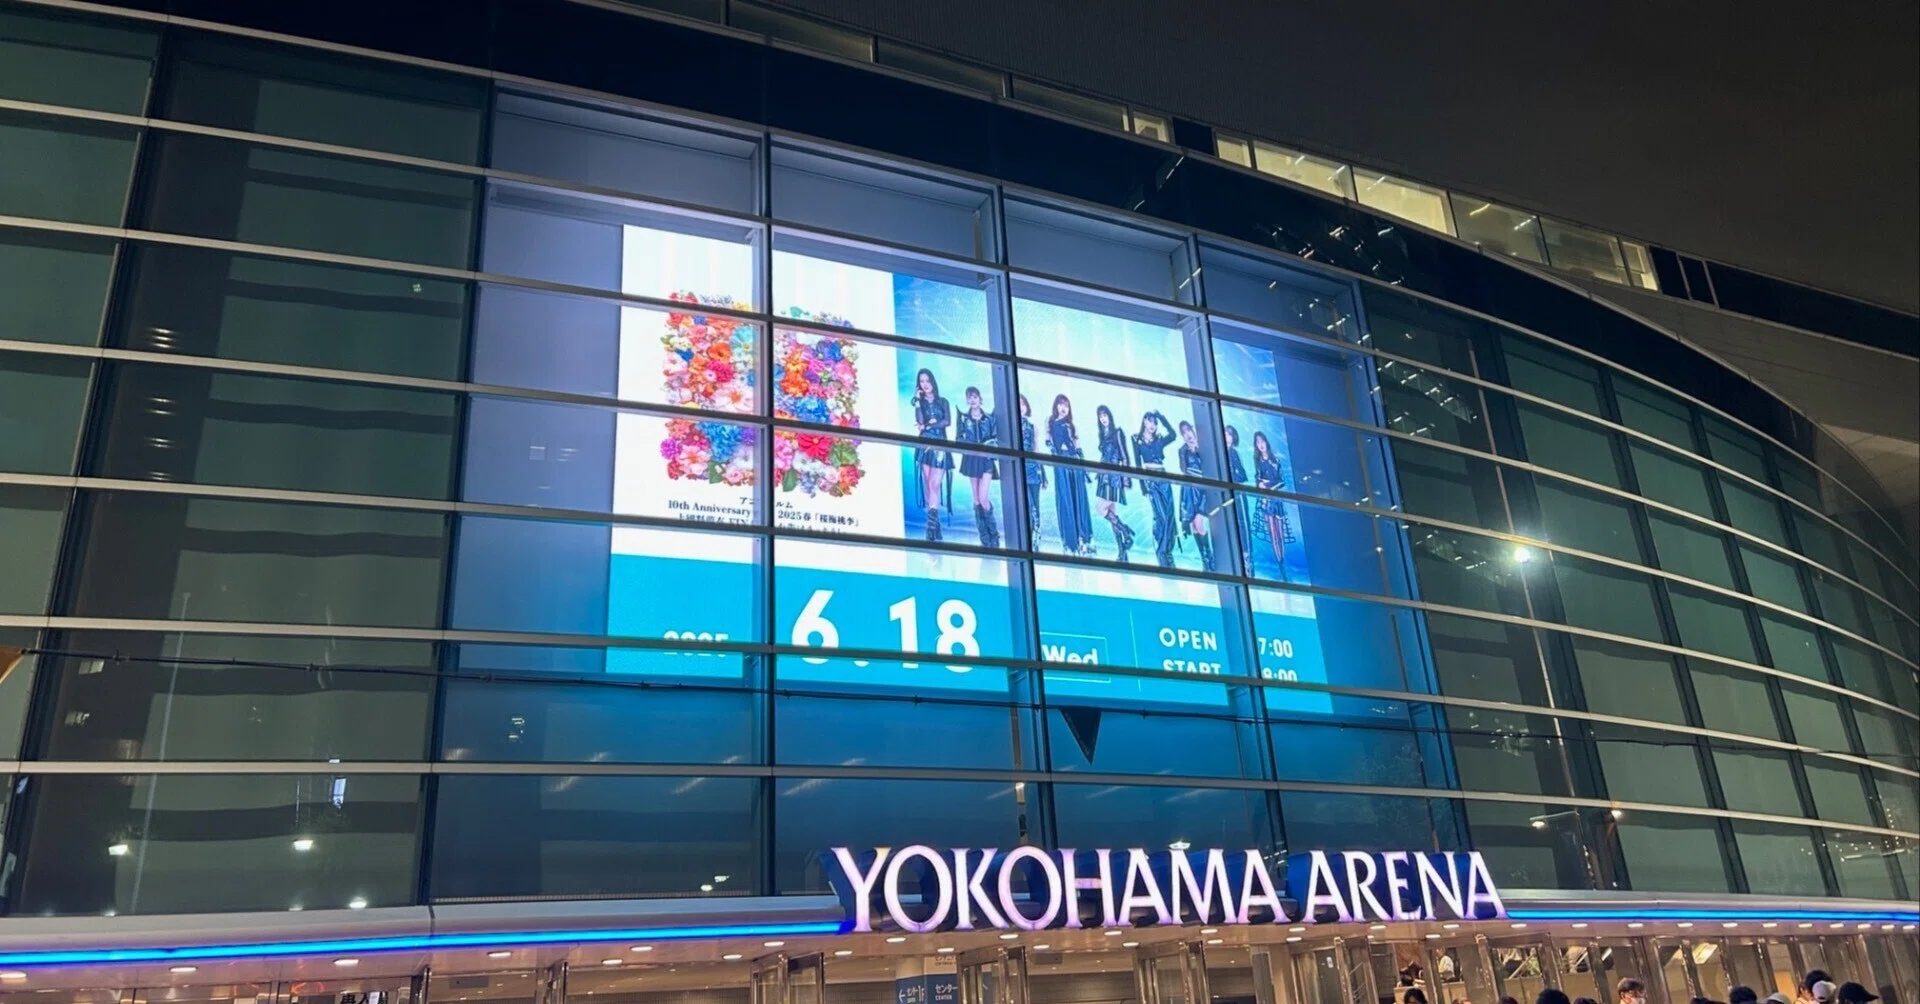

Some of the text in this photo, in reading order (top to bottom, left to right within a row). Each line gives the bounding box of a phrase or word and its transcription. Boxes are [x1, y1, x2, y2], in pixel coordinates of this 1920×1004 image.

[668, 500, 690, 509] 10th
[693, 502, 751, 517] Anniversary
[1159, 627, 1293, 658] OPEN 7:00
[830, 844, 1507, 933] YOKOHAMA ARENA
[935, 983, 958, 994] センター
